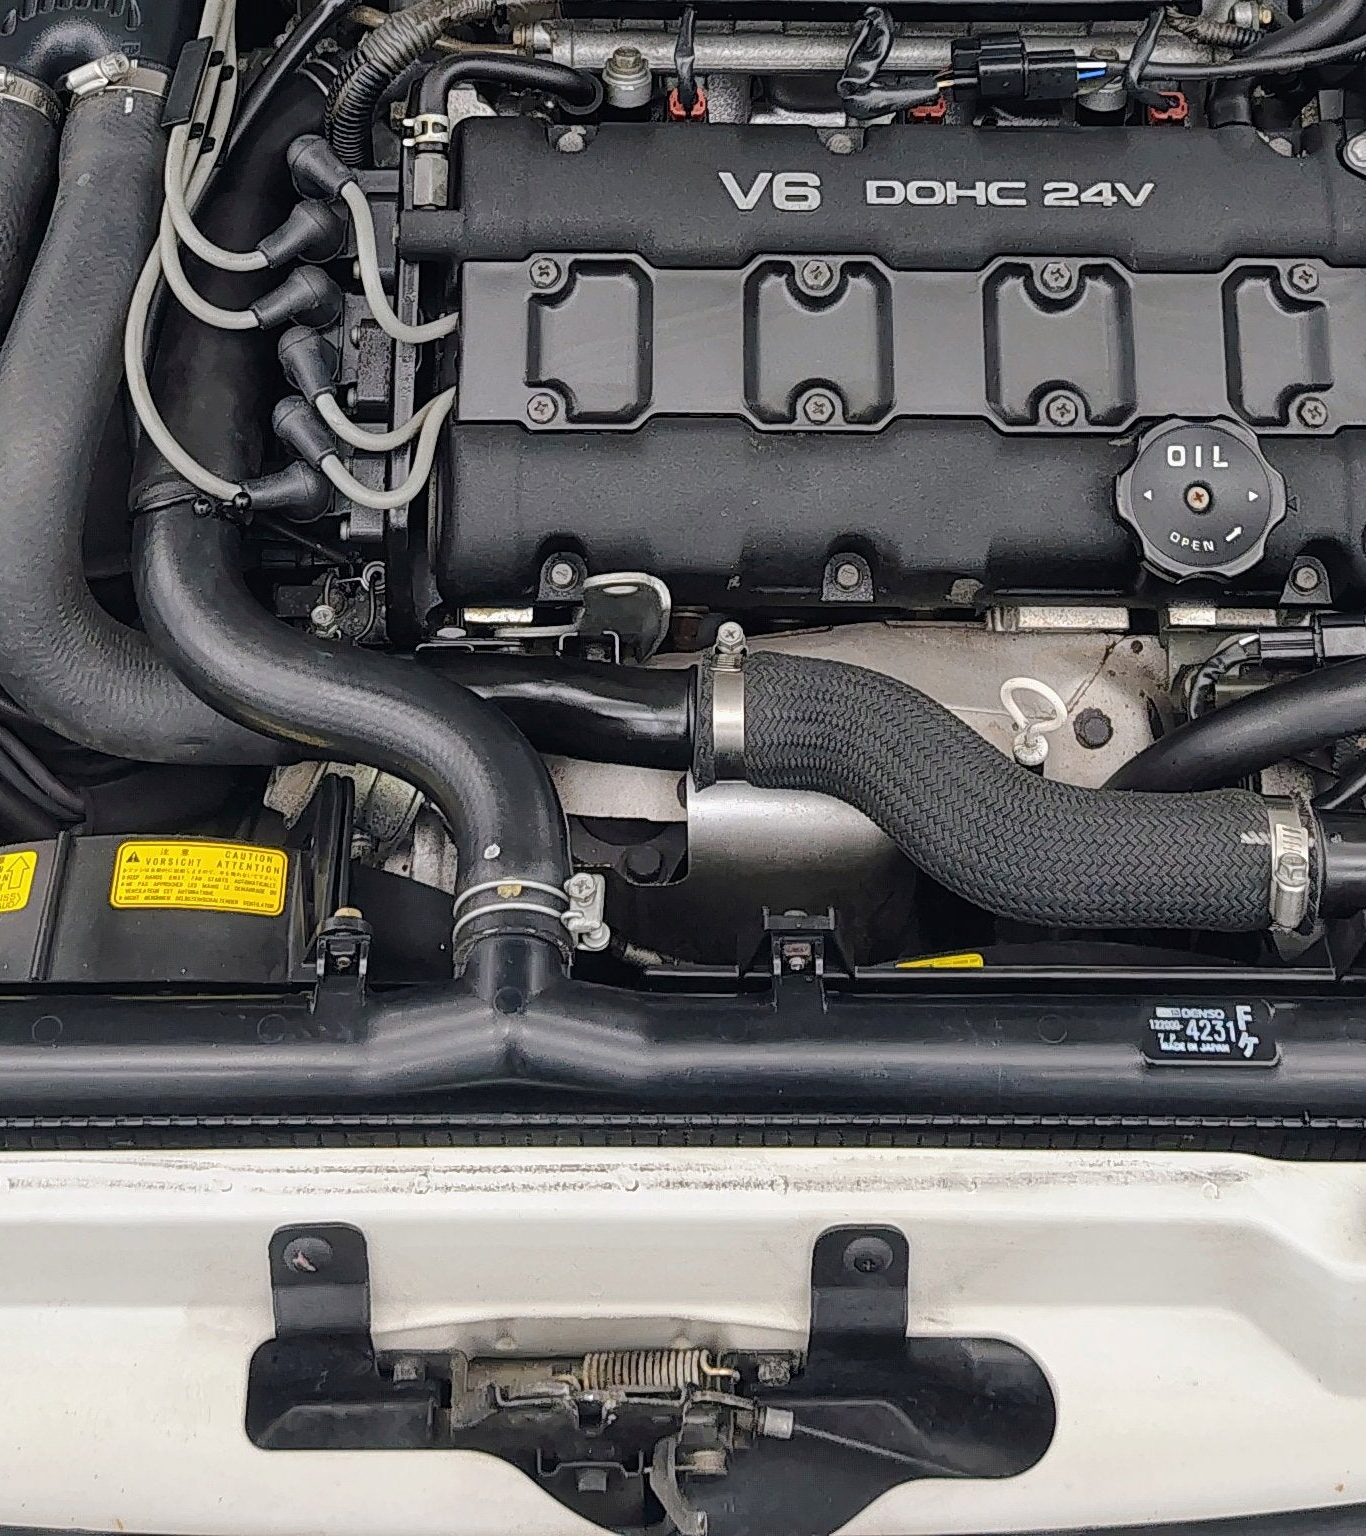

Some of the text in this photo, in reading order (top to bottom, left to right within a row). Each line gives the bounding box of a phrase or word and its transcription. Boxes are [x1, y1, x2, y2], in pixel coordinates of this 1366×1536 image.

[718, 171, 1155, 213] V6 DOHC 24V
[1166, 444, 1229, 468] OIL
[1168, 530, 1216, 552] OPEN
[145, 857, 202, 868] VORSICHT
[217, 860, 280, 874] ATTENTION
[225, 851, 274, 863] CAUTION
[1181, 1008, 1225, 1020] DENSO
[1235, 1005, 1252, 1030] F
